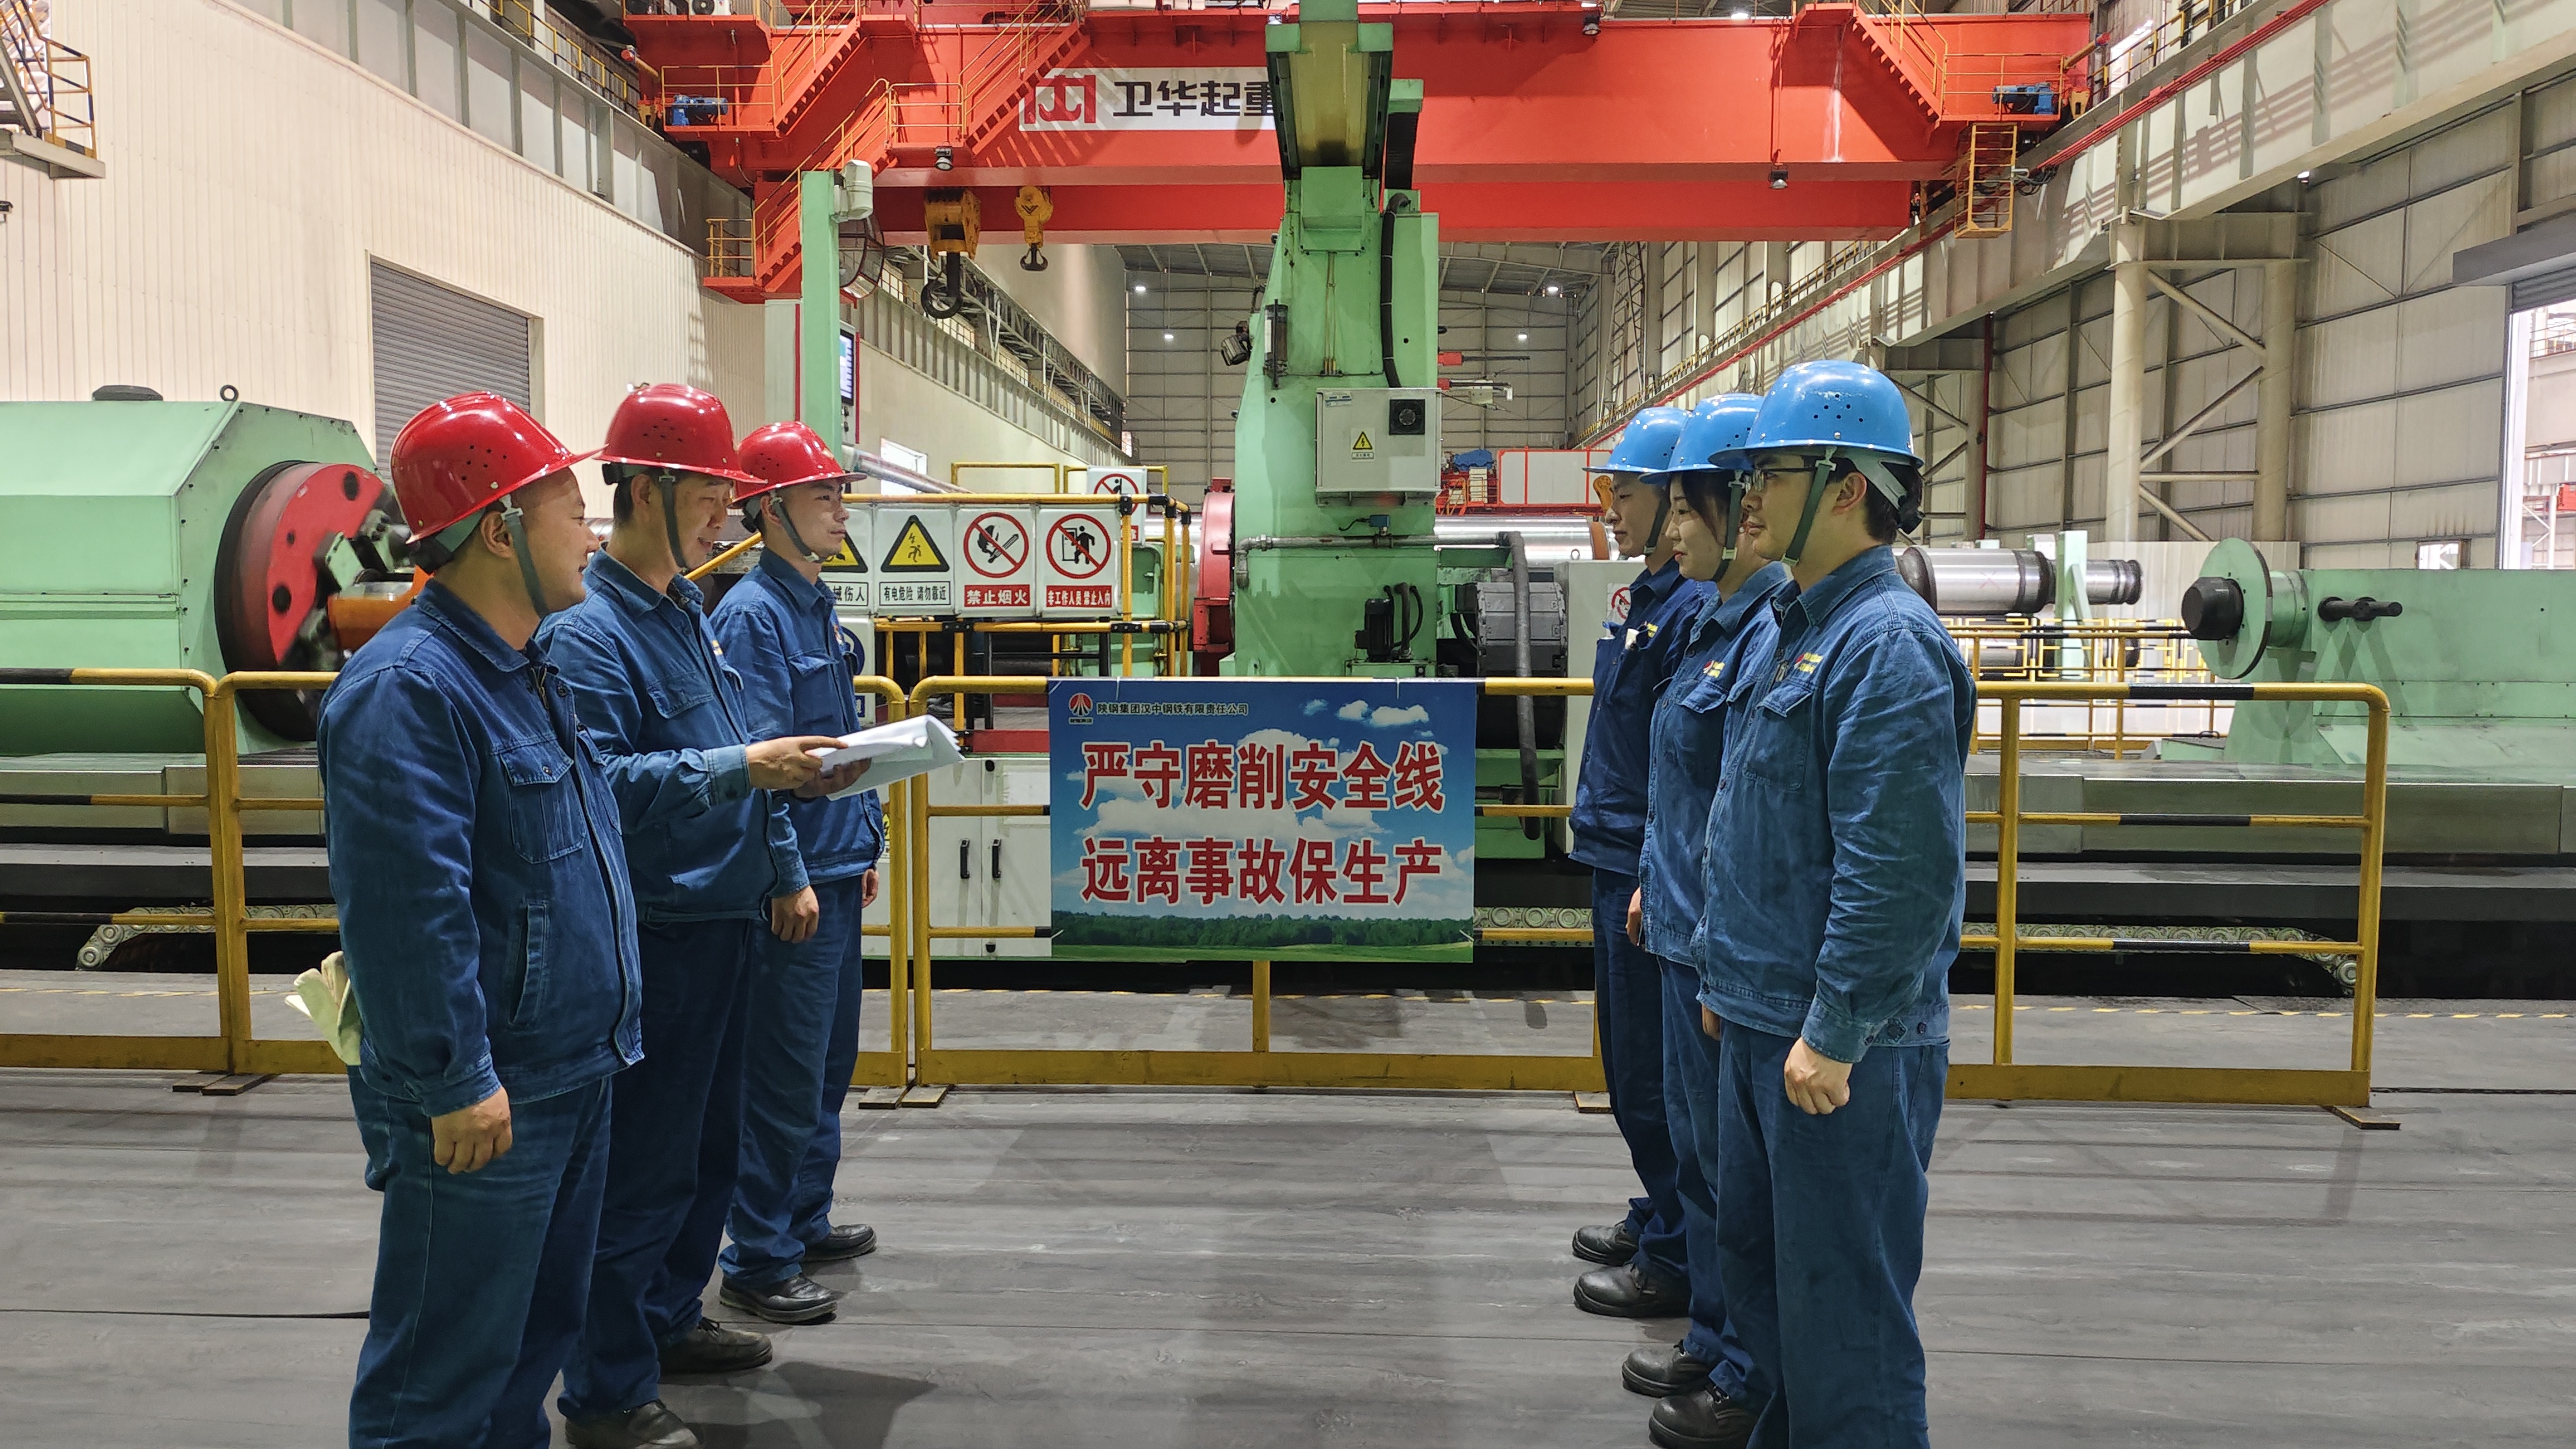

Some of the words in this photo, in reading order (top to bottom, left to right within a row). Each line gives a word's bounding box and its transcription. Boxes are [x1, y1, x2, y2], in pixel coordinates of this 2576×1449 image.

[1113, 80, 1274, 117] 卫华起重
[831, 585, 865, 602] 械伤人
[967, 589, 1028, 605] 禁止烟火
[1097, 702, 1248, 715] 陕钢集团汉中钢铁有限责任公司
[1080, 740, 1445, 813] 严守磨削安全线
[1080, 836, 1443, 906] 远离事故保生产
